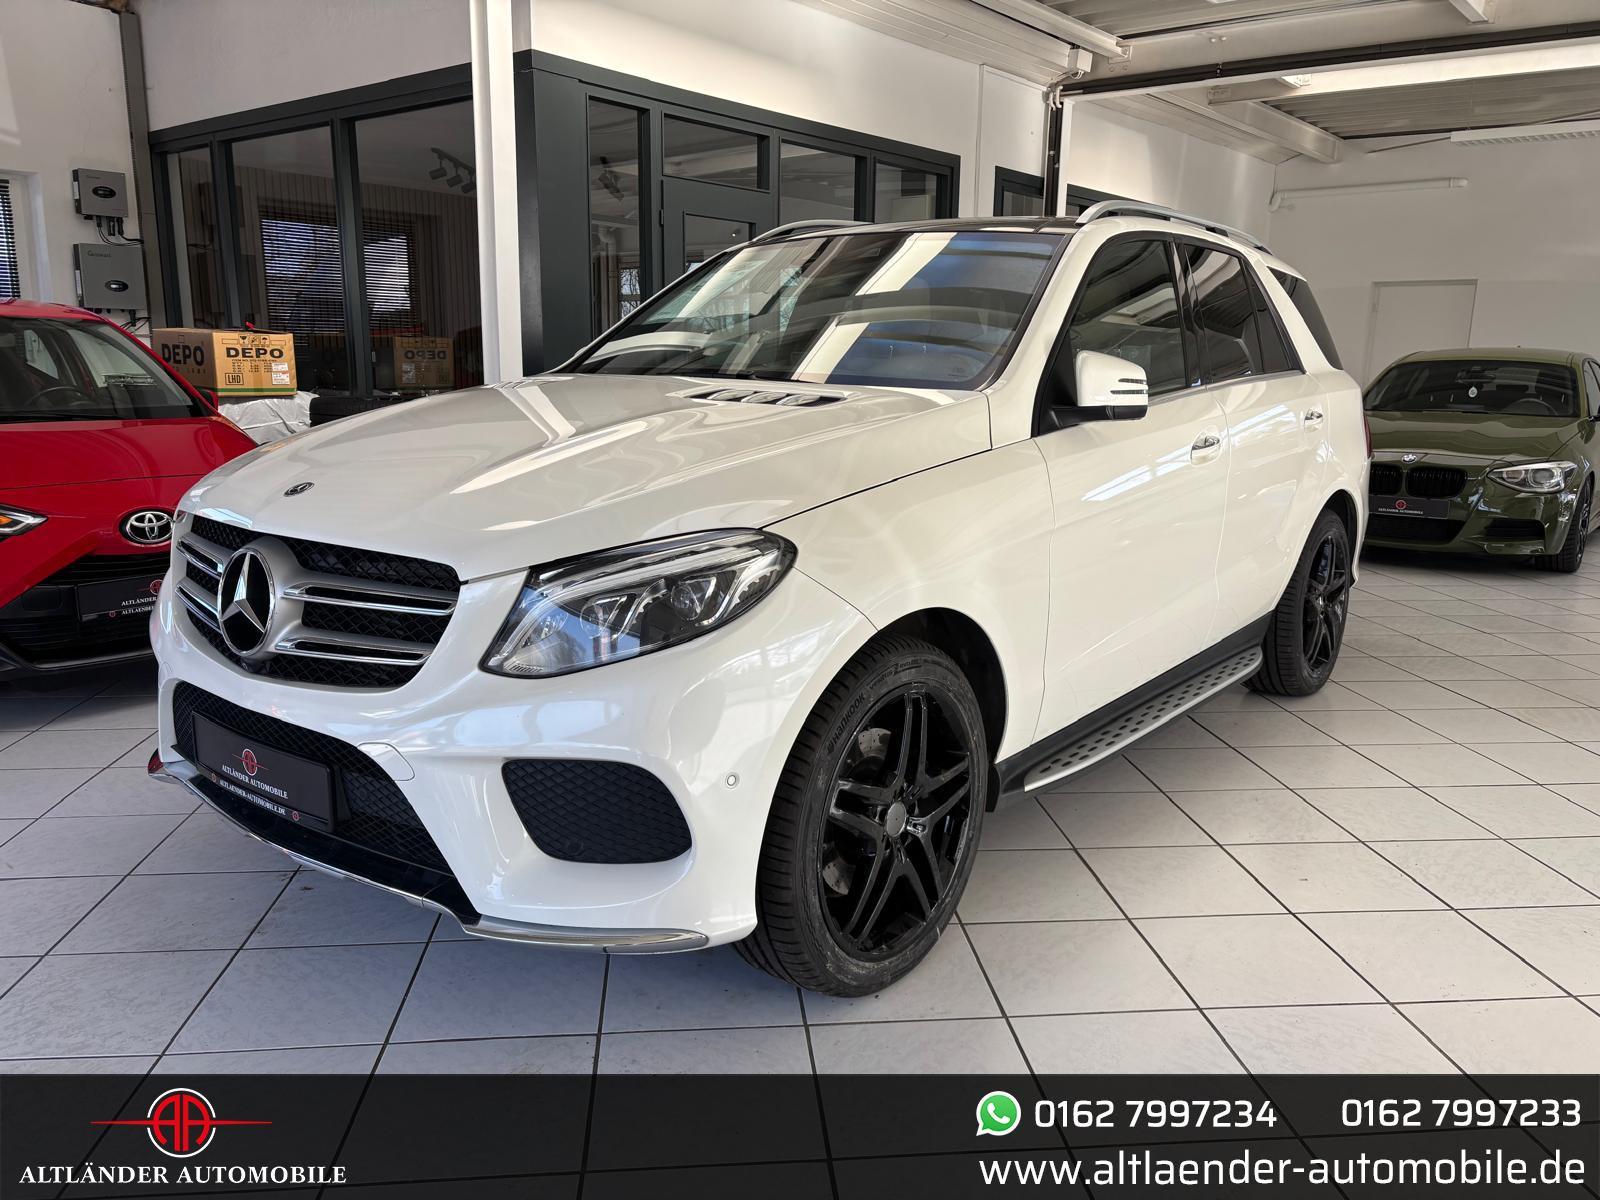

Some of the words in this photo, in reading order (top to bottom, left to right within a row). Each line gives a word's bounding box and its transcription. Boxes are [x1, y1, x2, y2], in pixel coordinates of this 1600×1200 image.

[161, 343, 205, 366] DEPO
[226, 347, 284, 358] DEPO
[227, 375, 241, 384] LHD
[250, 778, 288, 799] AUTOMOBILE
